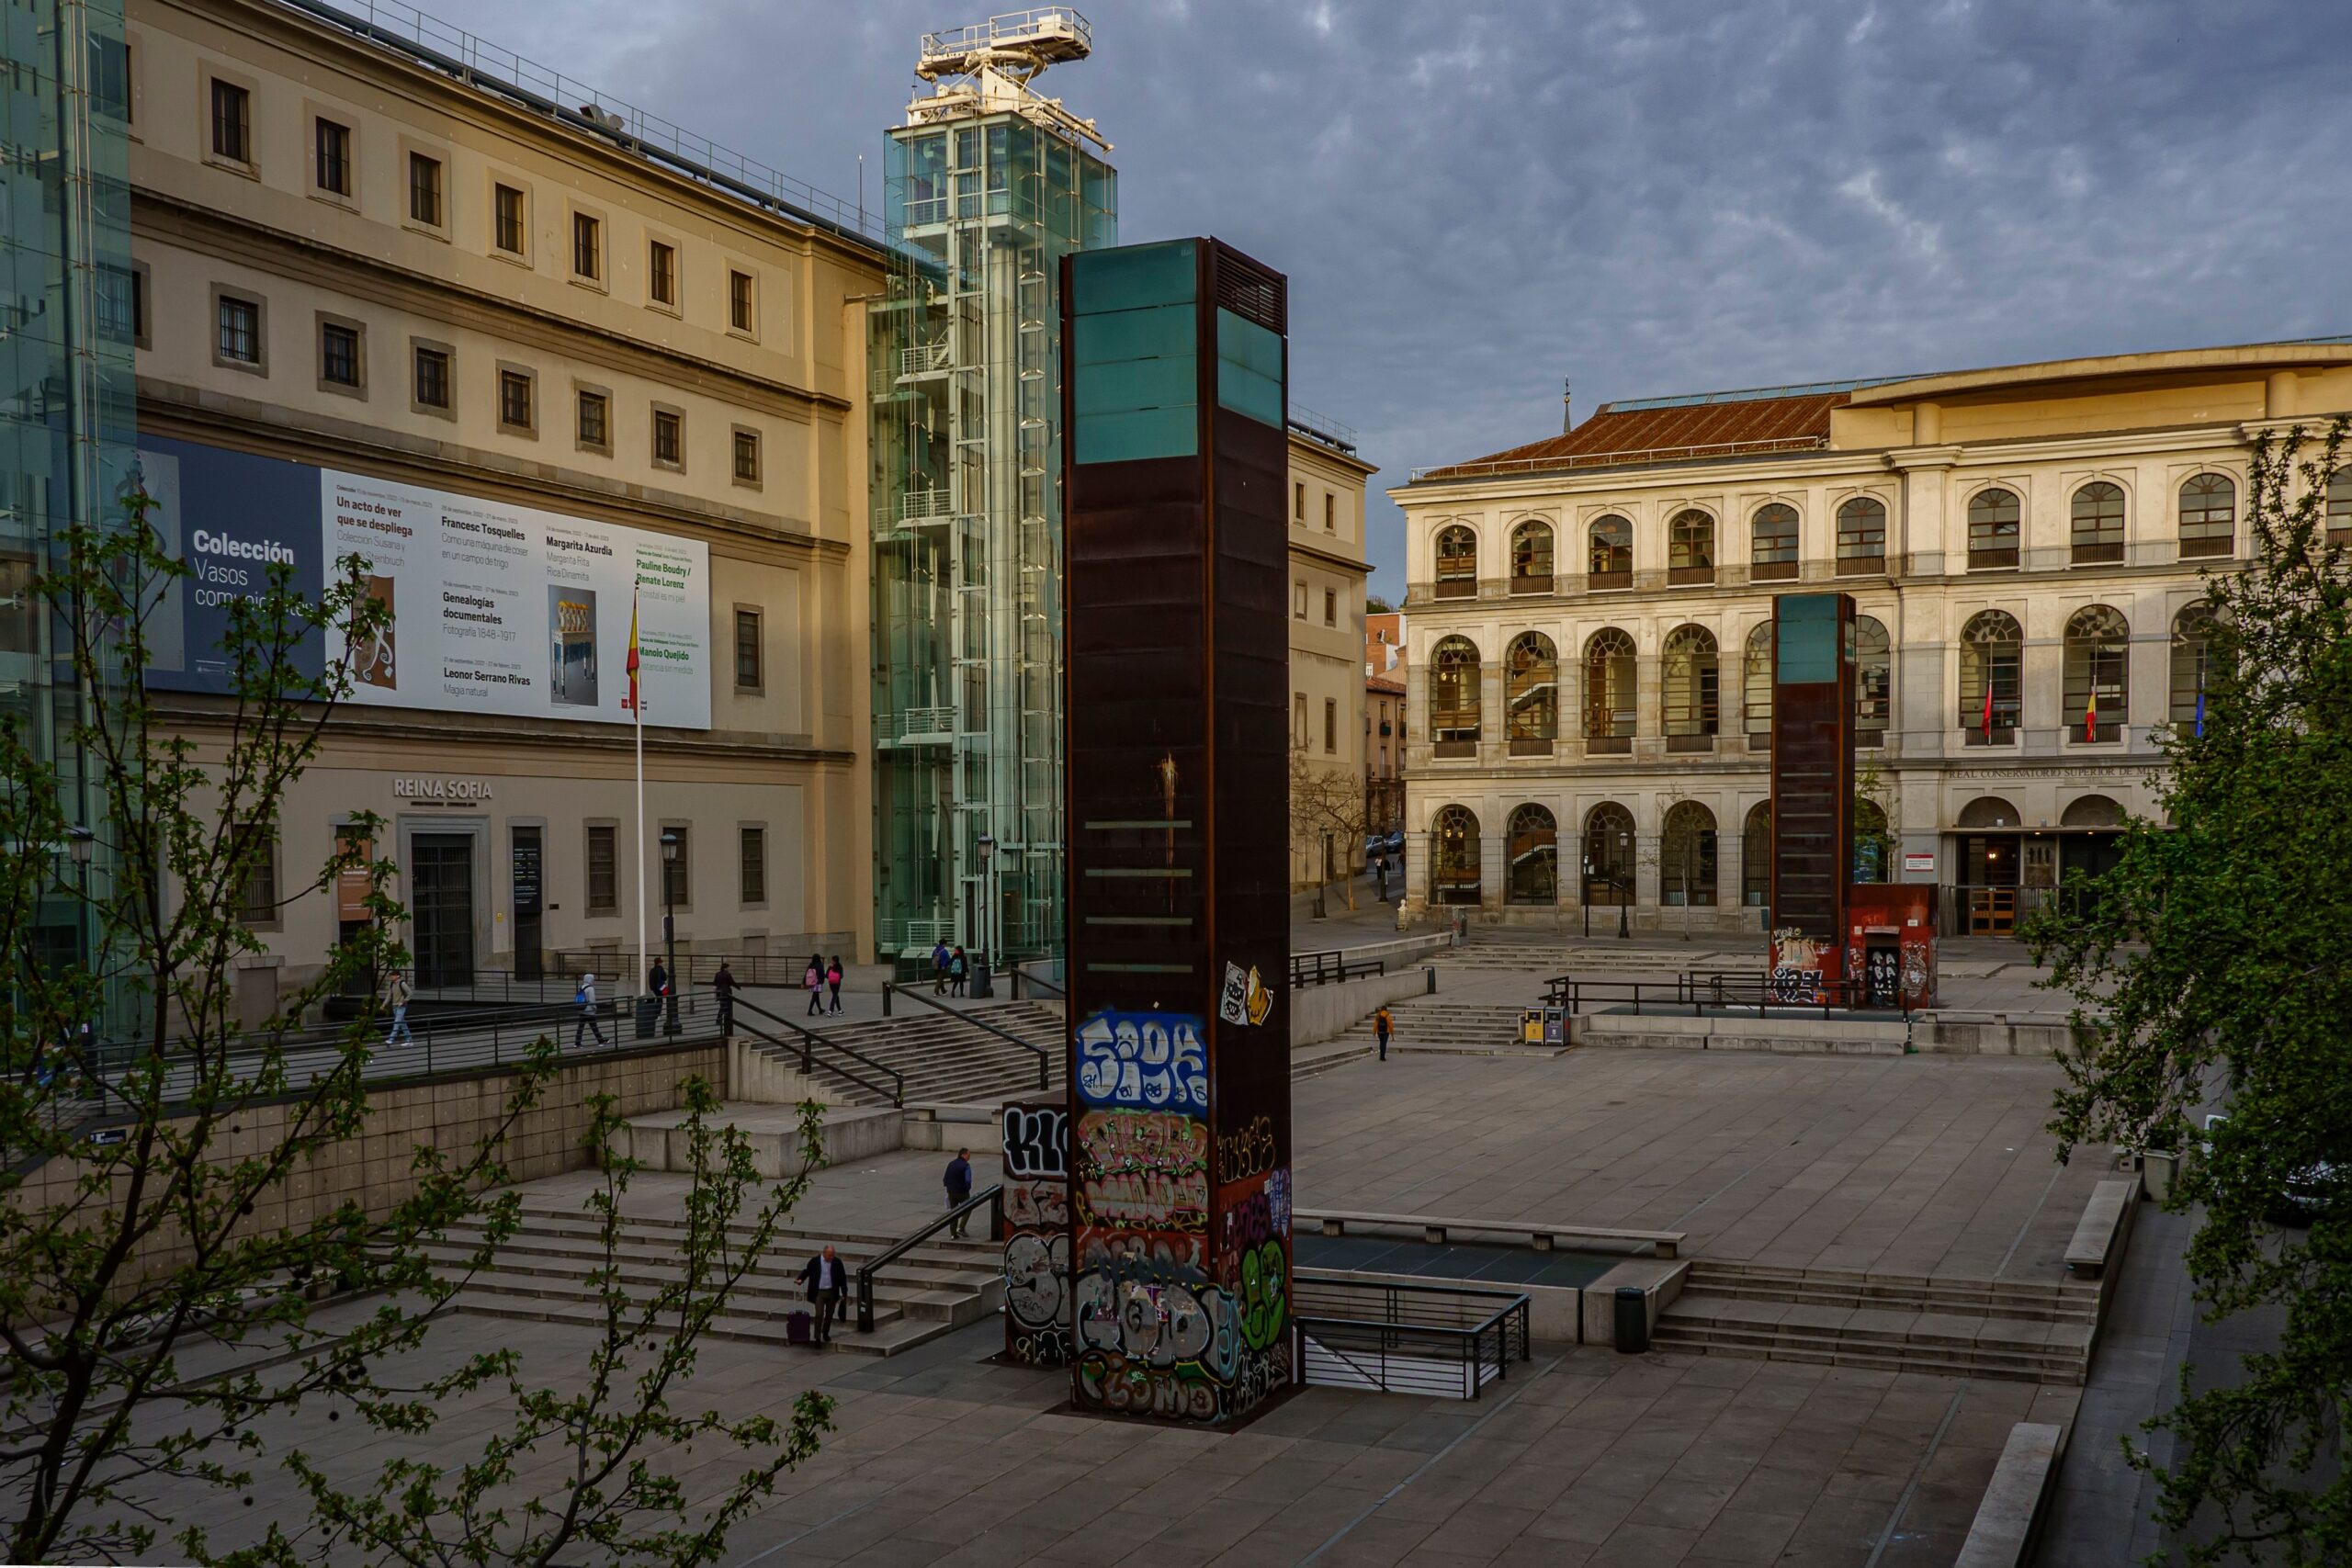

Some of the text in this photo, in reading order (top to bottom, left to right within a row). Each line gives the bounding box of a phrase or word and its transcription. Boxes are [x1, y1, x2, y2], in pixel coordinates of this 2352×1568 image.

[337, 496, 350, 508] Un
[352, 502, 372, 513] acto
[375, 503, 386, 514] de
[387, 507, 401, 518] ver
[337, 515, 413, 537] que se despliega
[441, 516, 526, 540] Francesc Tosquelles
[193, 529, 295, 565] Colección
[546, 536, 613, 557] Margarita Azurdia
[194, 557, 248, 586] Vasos
[636, 558, 662, 572] Pauline
[662, 563, 686, 578] Boudry
[662, 577, 684, 589] Lorenz
[443, 592, 494, 609] Genealogías
[443, 607, 503, 625] documentales
[663, 649, 689, 661] Quejido
[444, 667, 531, 686] Leonor Serrano Rivas
[1949, 770, 1977, 779] REAL
[1980, 769, 2062, 779] CONSERVATORIO
[2064, 767, 2115, 777] SUPERIOR
[2119, 766, 2132, 775] DE
[394, 779, 445, 798] REINA
